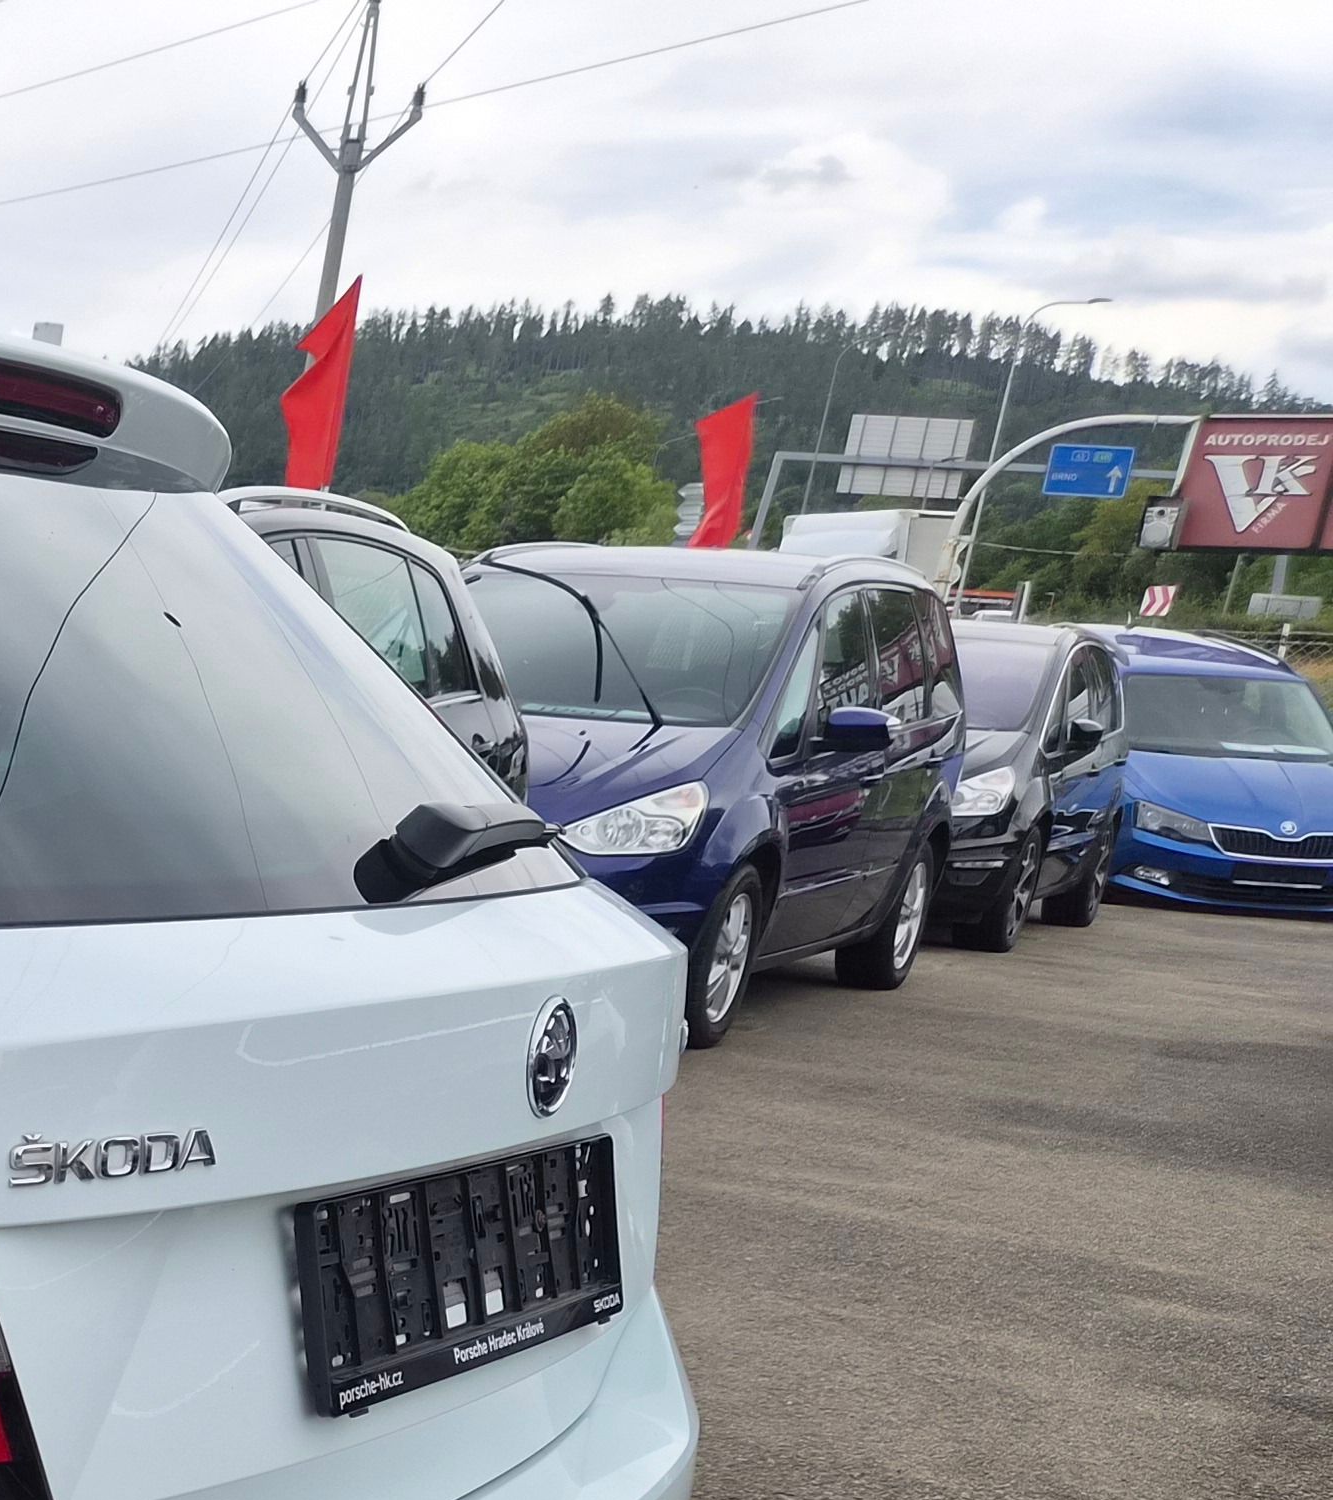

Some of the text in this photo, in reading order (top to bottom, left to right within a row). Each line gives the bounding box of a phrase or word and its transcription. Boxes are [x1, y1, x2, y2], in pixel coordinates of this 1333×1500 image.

[1204, 433, 1331, 446] AUTOPRODEJ
[8, 1127, 217, 1187] ŠKODA
[453, 1317, 545, 1364] Porsche Hradec Králové
[339, 1371, 404, 1410] porsche-hk.cz
